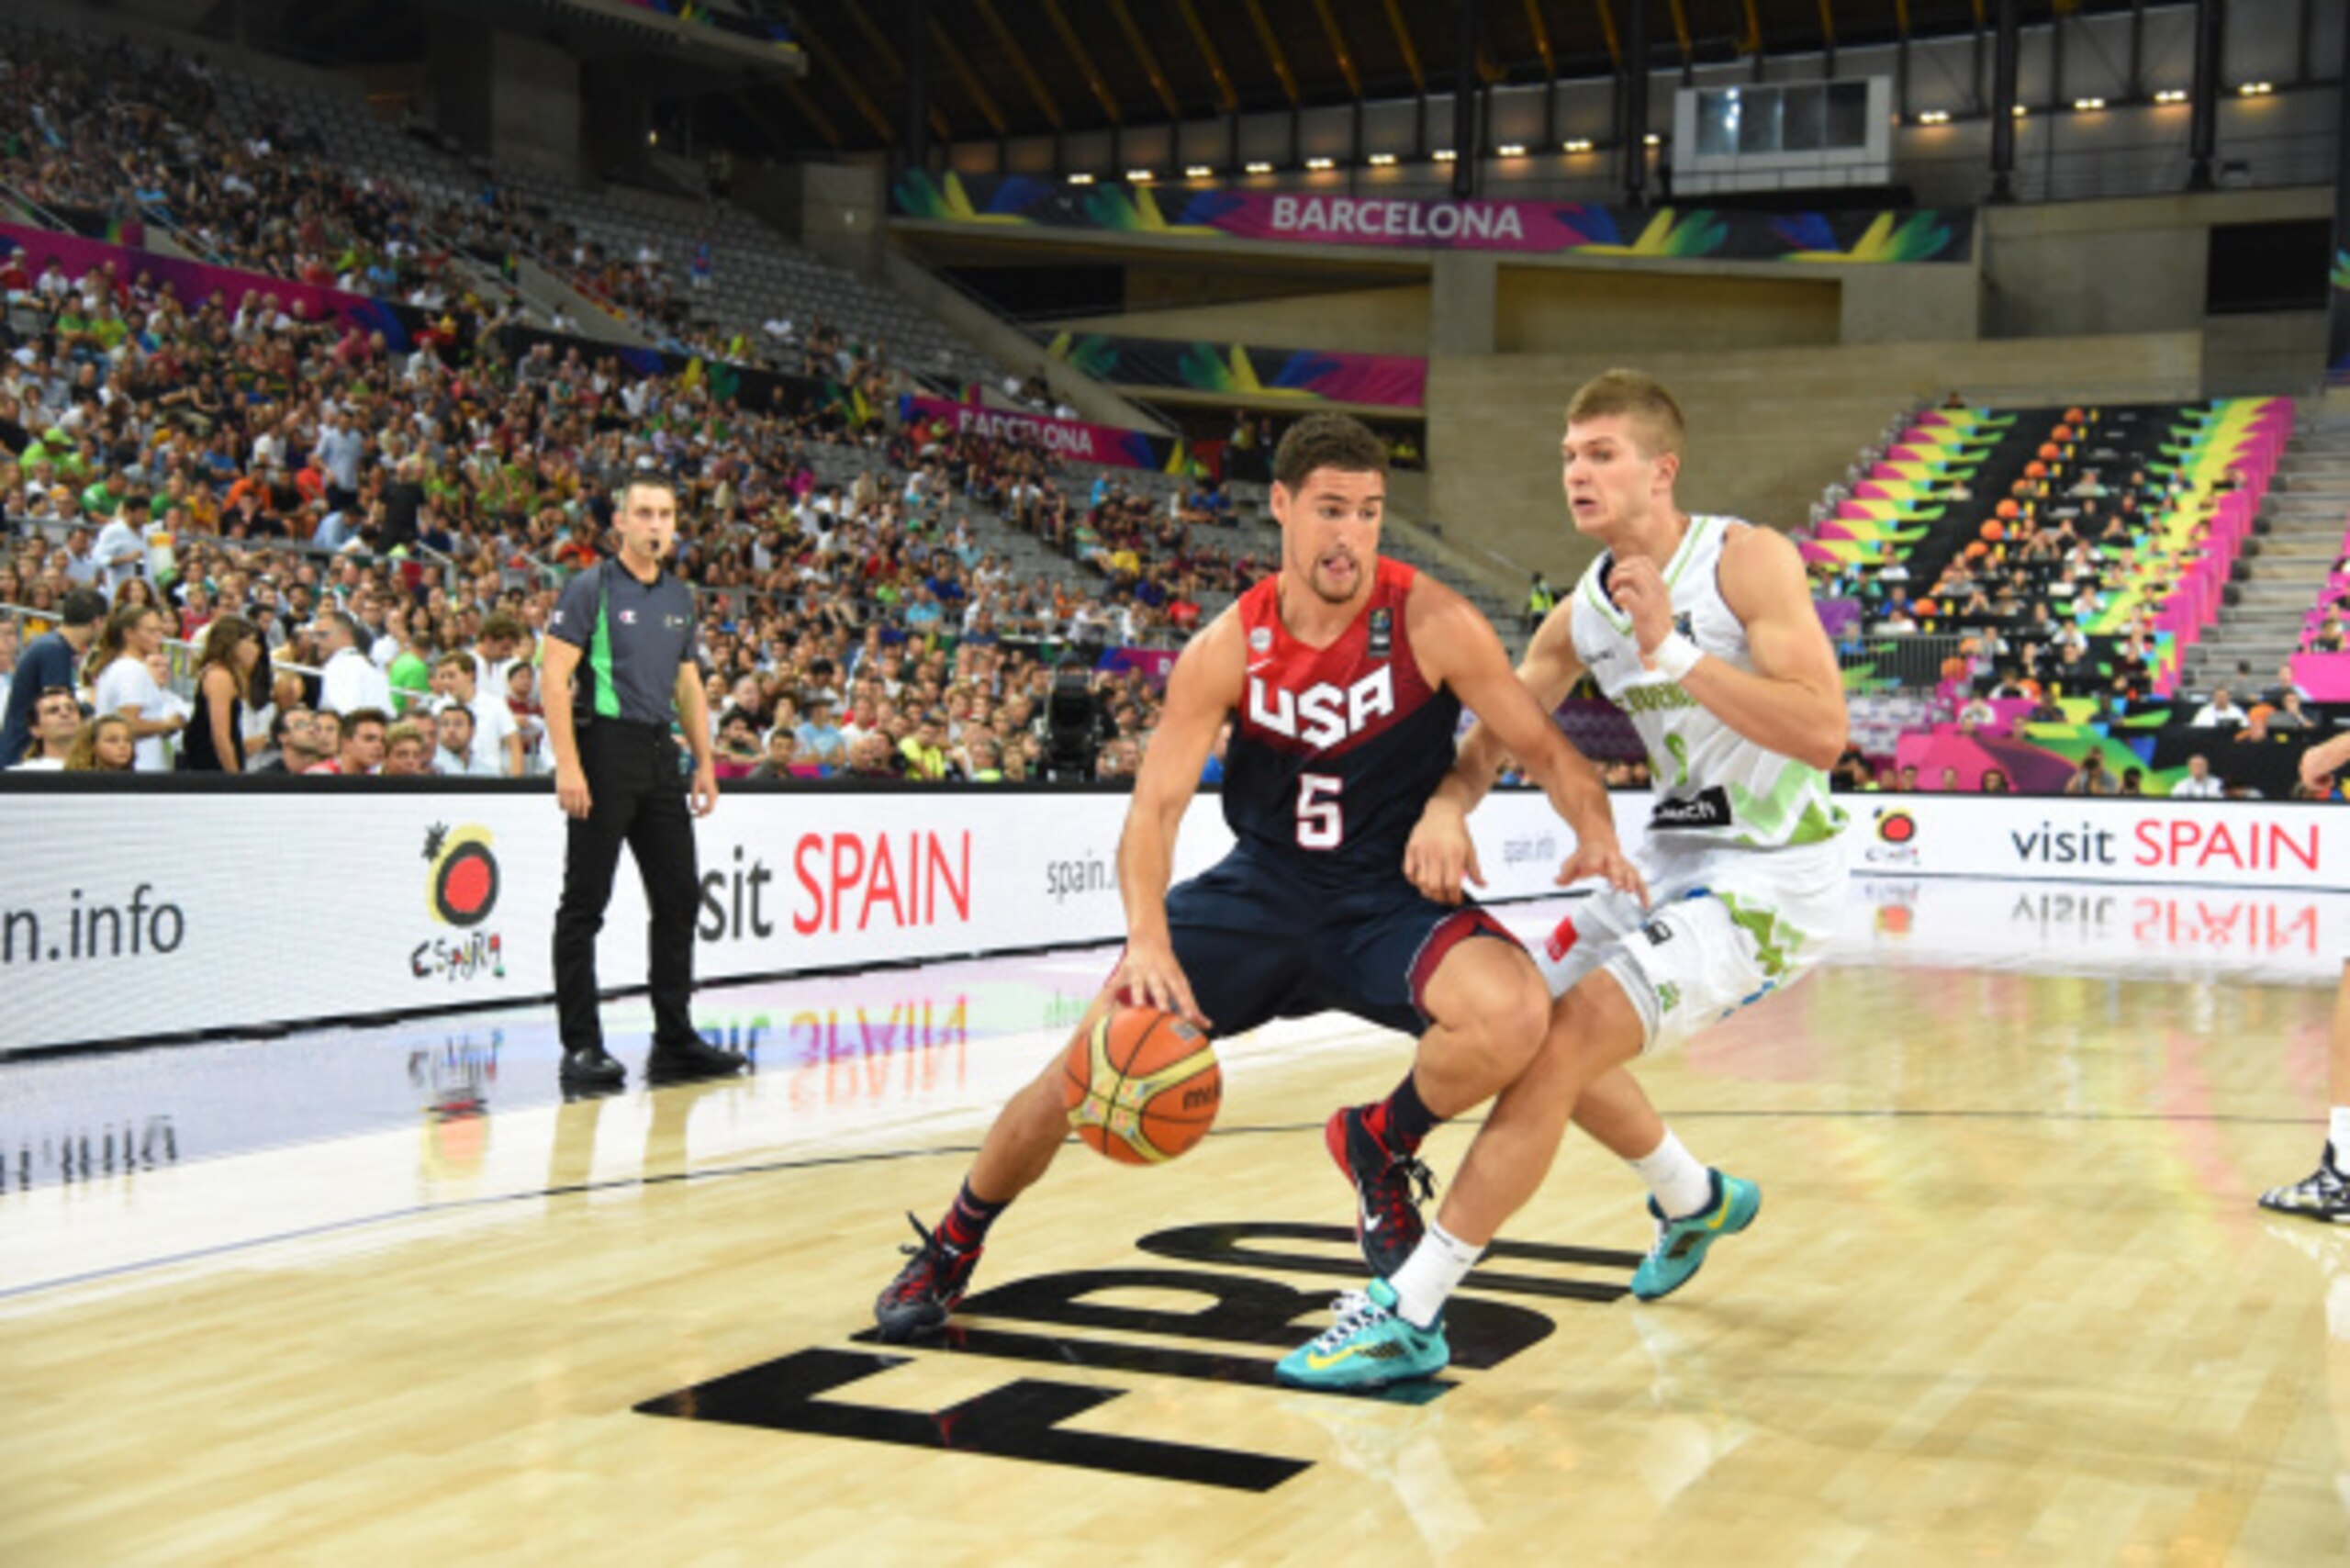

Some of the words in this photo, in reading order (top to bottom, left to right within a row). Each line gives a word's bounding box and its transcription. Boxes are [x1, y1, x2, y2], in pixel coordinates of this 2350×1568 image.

[1270, 196, 1524, 241] BARCELONA
[1248, 661, 1395, 750] USA
[1295, 772, 1344, 850] 5
[2010, 820, 2116, 865] visit
[2133, 819, 2320, 871] SPAIN
[792, 828, 970, 936] SPAIN
[3, 883, 185, 964] n.info
